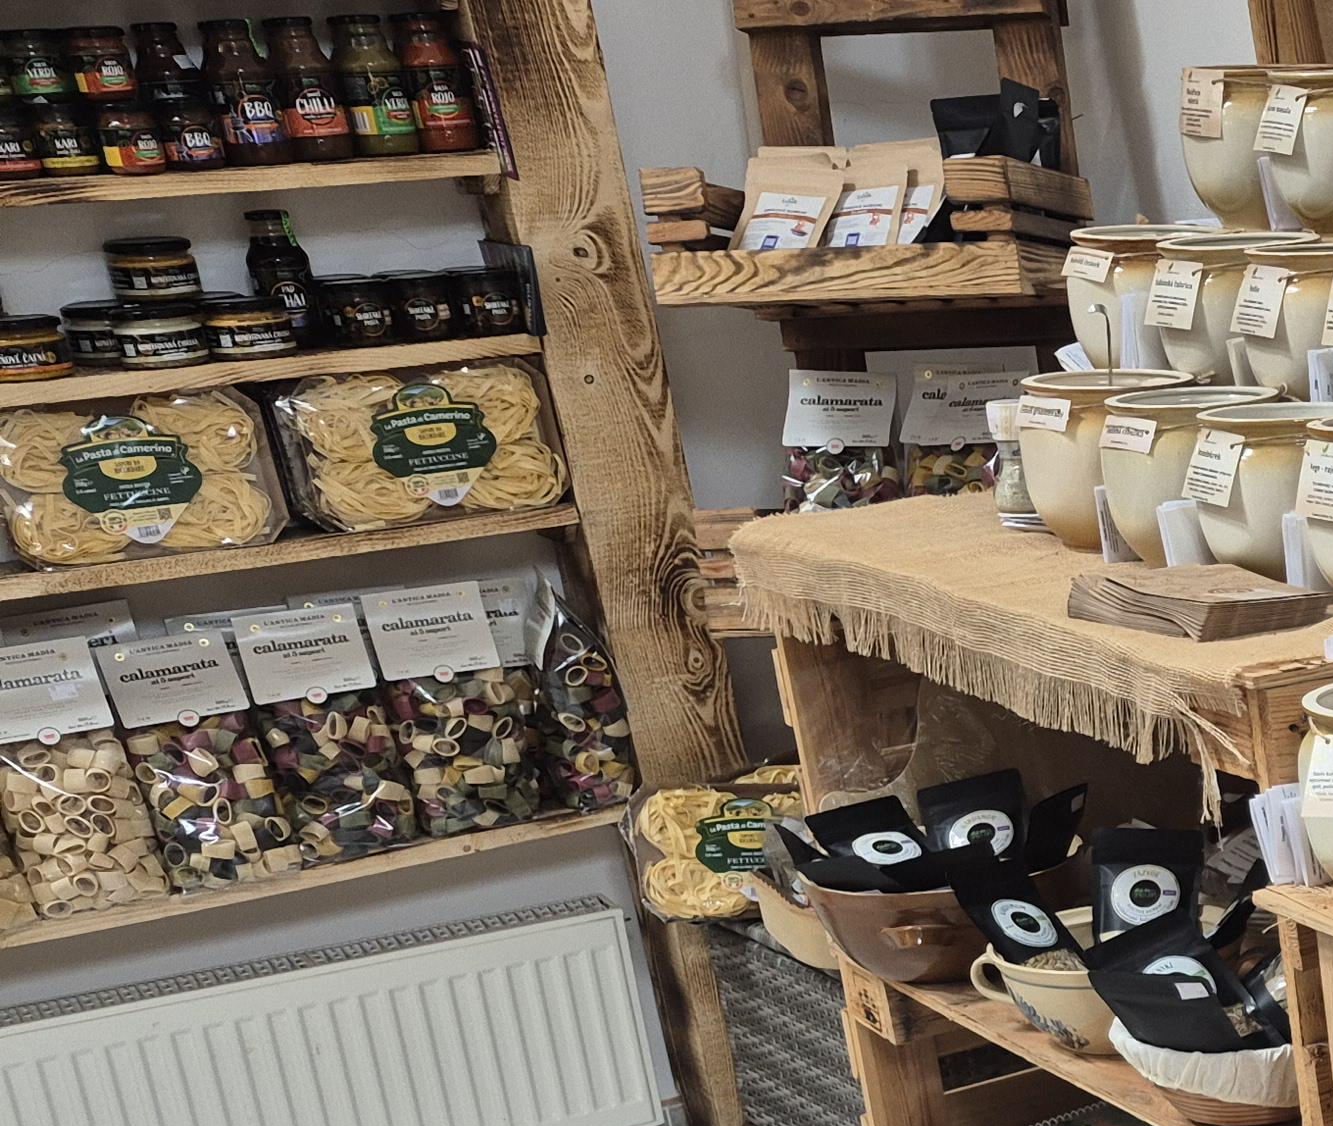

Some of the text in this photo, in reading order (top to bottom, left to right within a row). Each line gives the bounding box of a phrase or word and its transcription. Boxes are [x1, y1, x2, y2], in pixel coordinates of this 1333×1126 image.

[244, 101, 275, 119] BBQ
[184, 132, 213, 148] BBQ
[799, 393, 884, 408] calamarata
[390, 411, 471, 428] Pasta Camerino
[82, 443, 173, 461] Pasta Camerino
[408, 451, 469, 466] FETTUCCINE
[380, 608, 475, 634] calamarata
[253, 631, 350, 655] calamarata
[119, 655, 220, 685] calamarata
